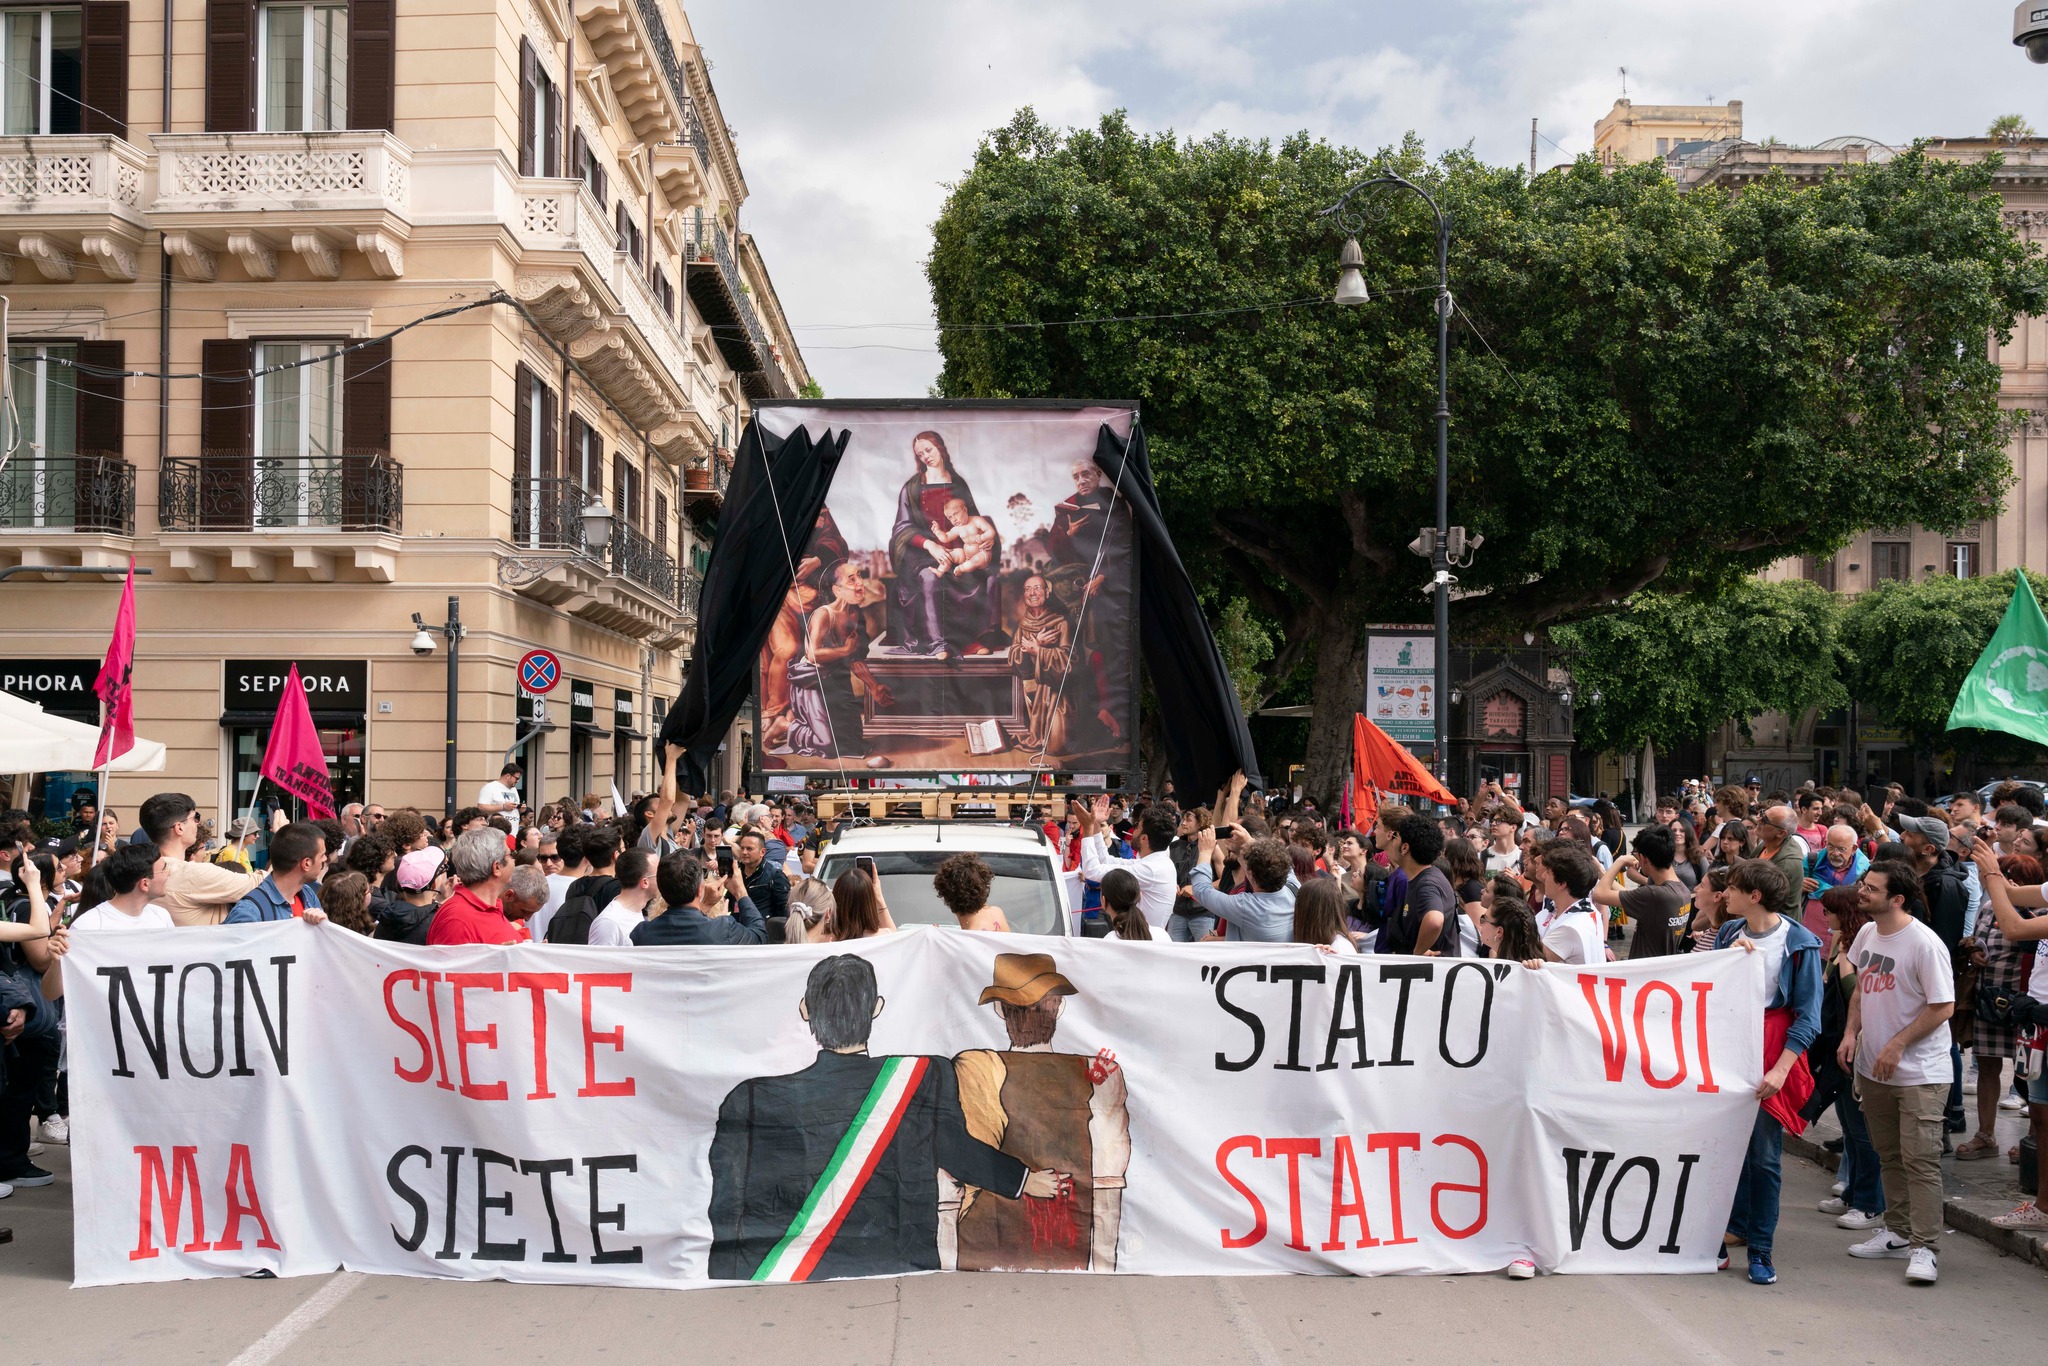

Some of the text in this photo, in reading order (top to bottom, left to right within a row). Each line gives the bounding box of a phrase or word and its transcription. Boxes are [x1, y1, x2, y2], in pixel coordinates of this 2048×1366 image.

[4, 675, 84, 691] PHORA
[96, 955, 1720, 1101] NON SIETE "STATO" VOI
[129, 1143, 282, 1261] MA
[386, 1144, 644, 1265] SIETE
[1562, 1147, 1700, 1255] VOI
